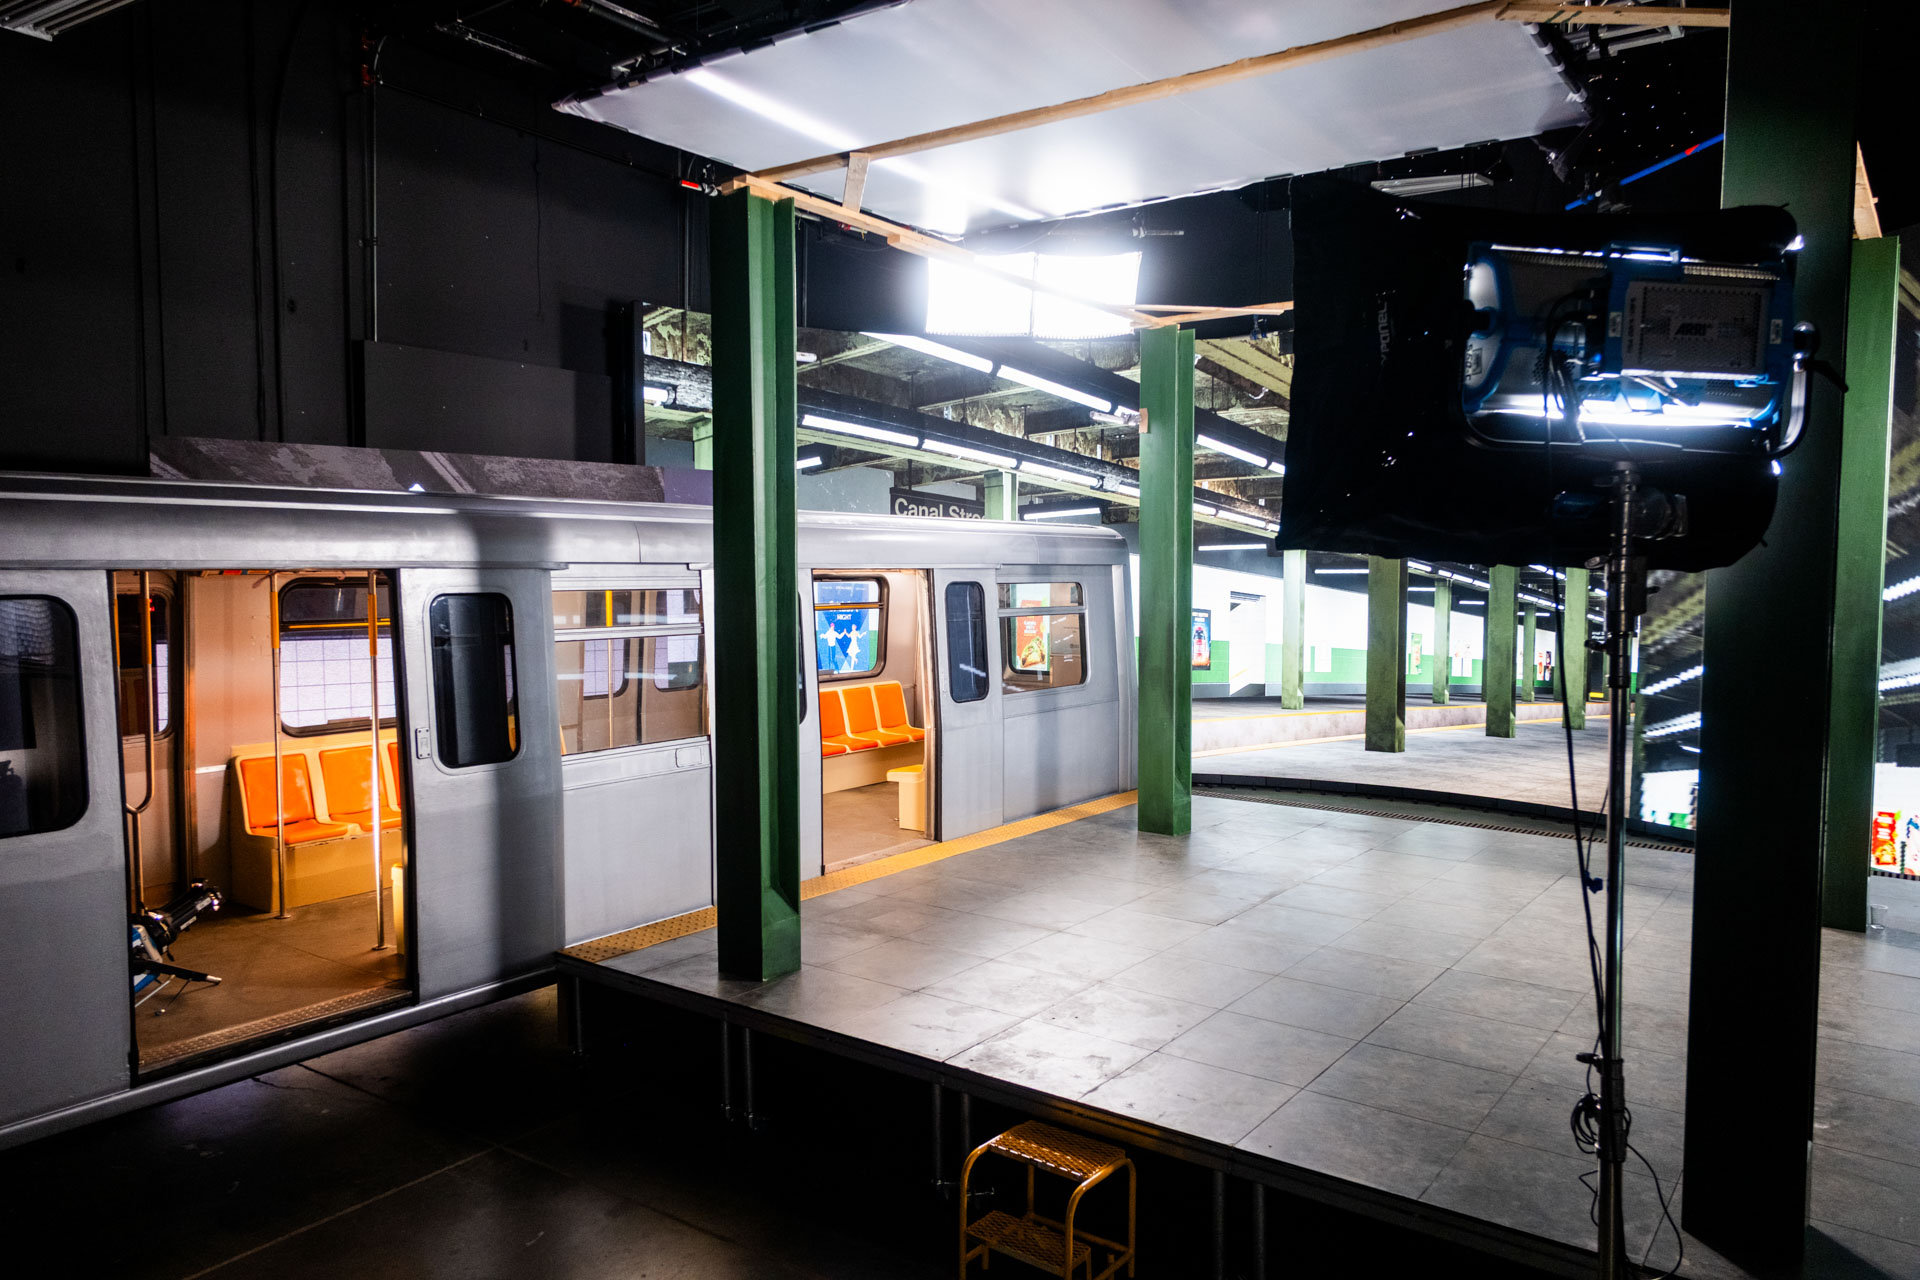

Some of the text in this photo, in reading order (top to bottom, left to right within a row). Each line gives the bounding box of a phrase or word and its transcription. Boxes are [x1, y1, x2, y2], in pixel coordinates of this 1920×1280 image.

[1674, 322, 1709, 336] ARRI
[895, 498, 985, 519] Canal Stre
